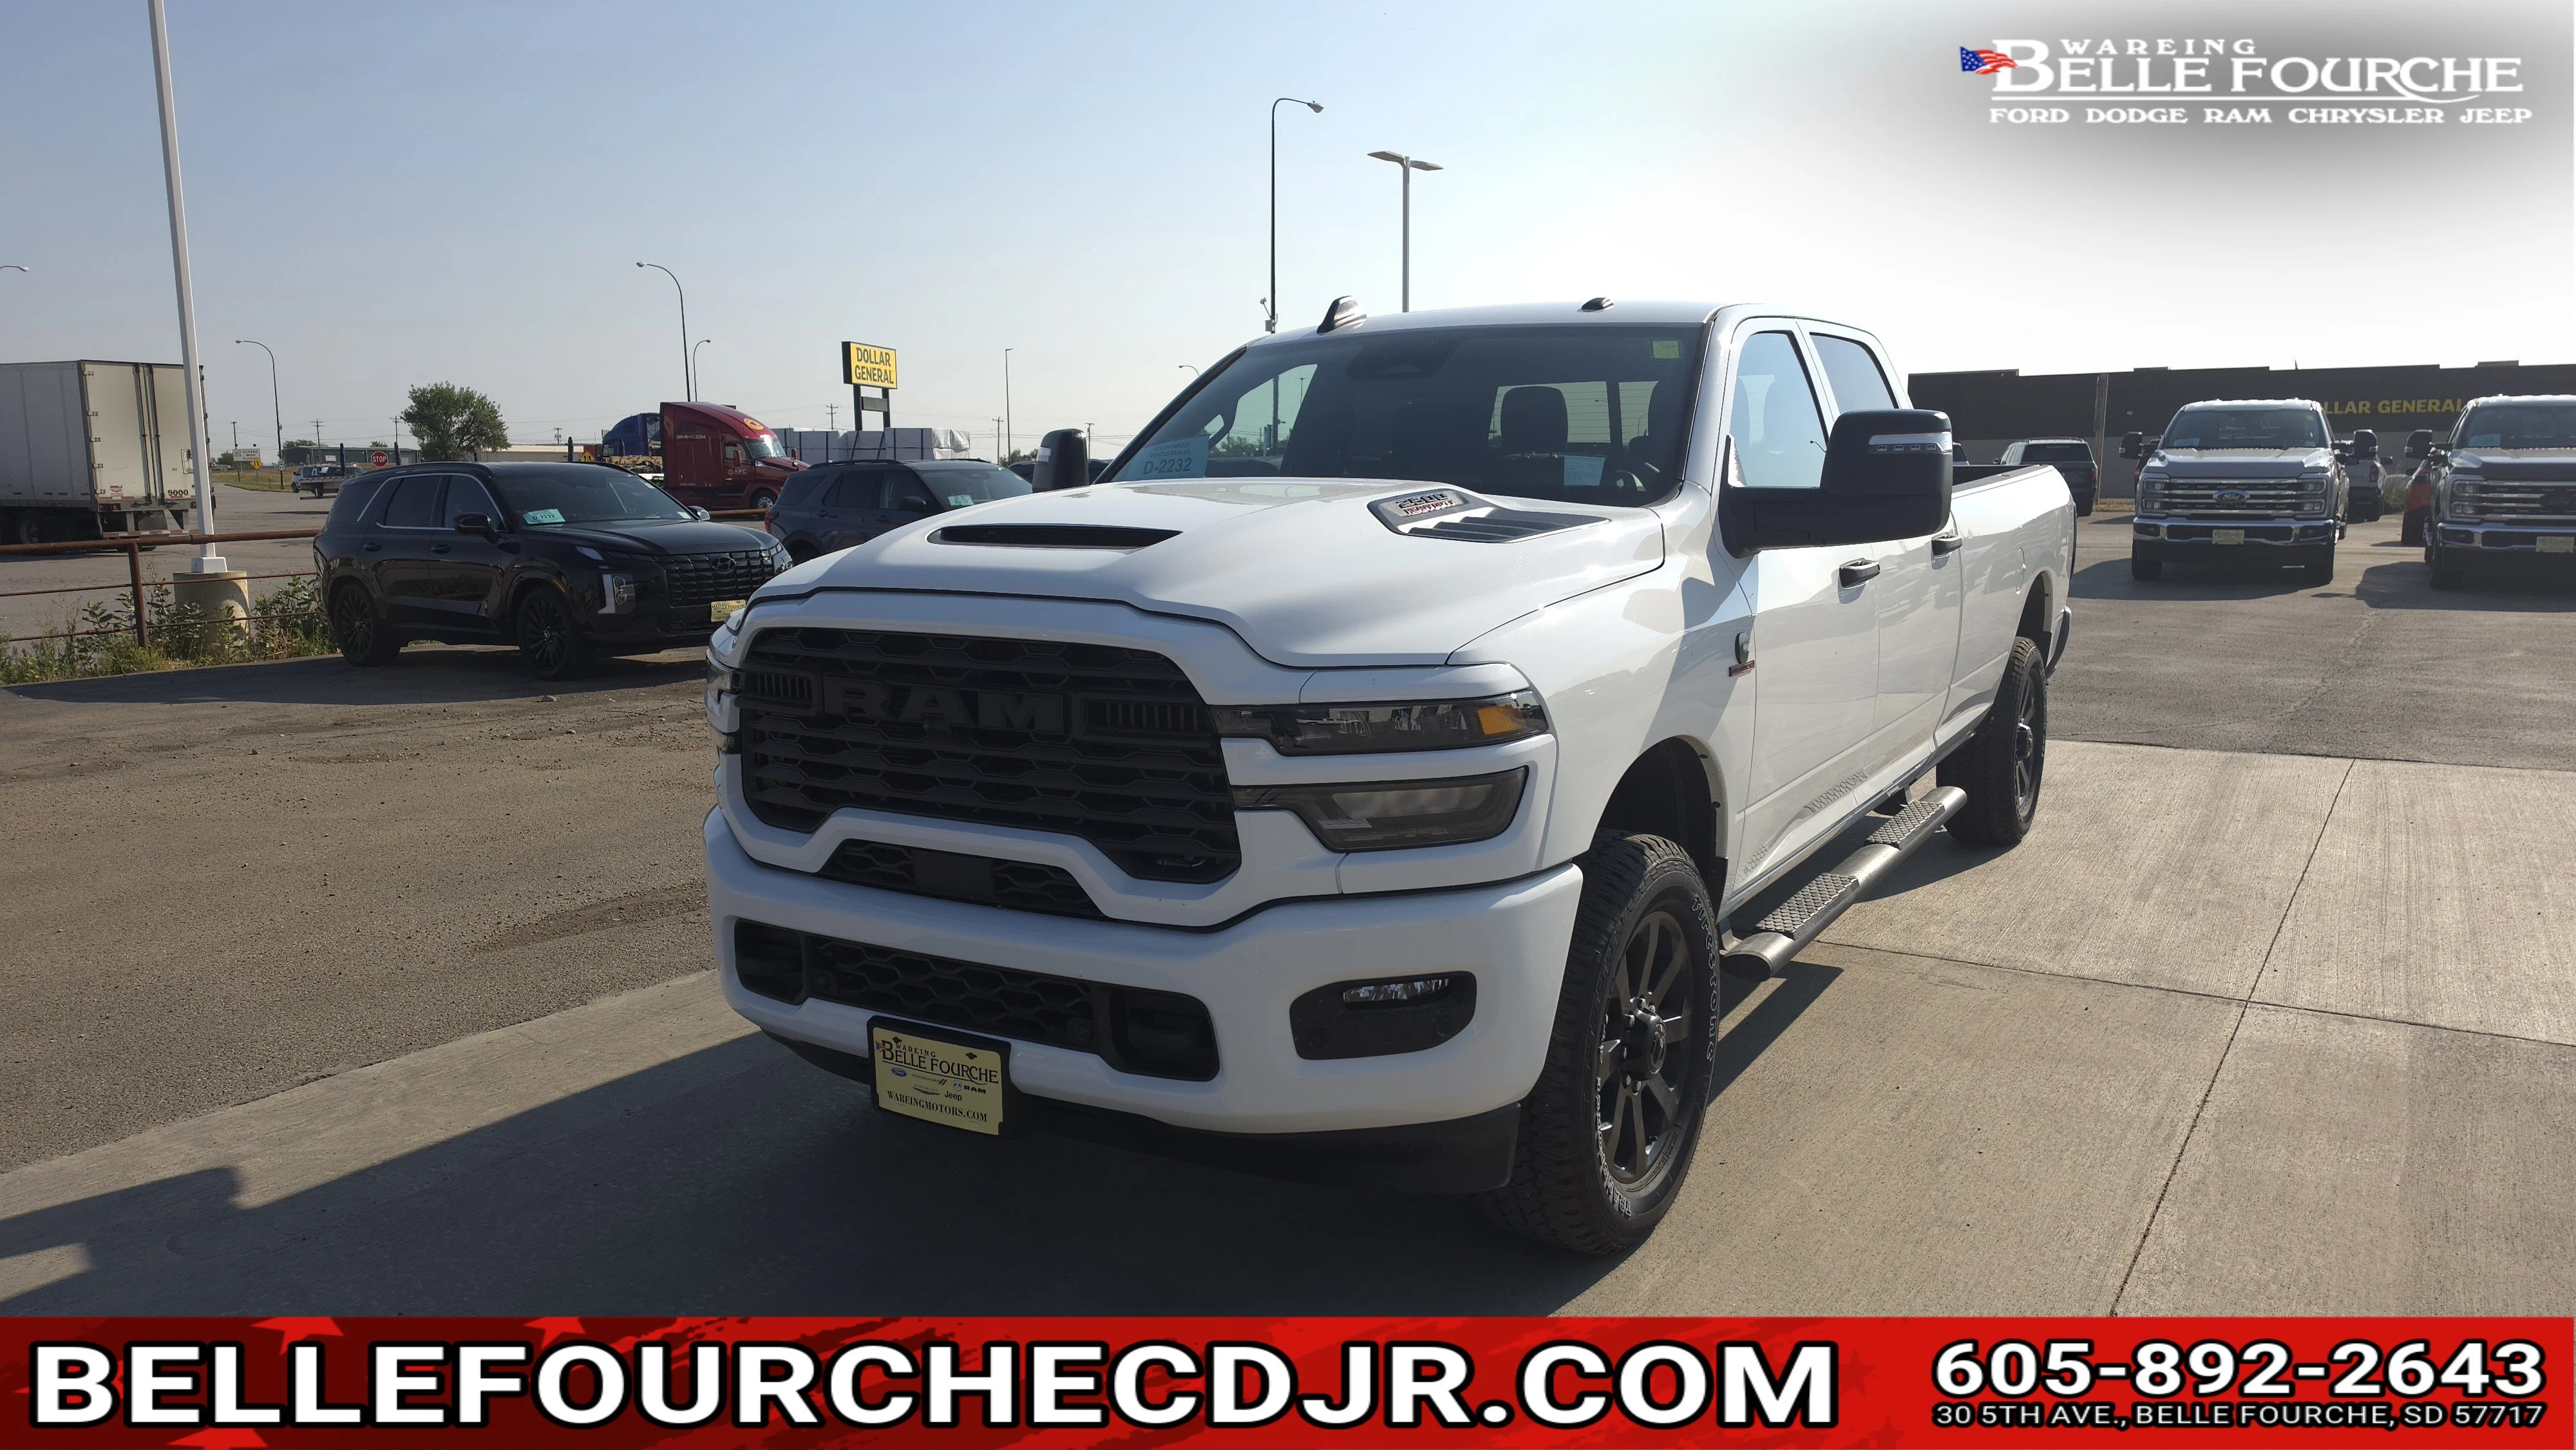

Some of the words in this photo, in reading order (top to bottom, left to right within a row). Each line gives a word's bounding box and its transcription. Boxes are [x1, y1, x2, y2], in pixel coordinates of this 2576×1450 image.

[855, 347, 891, 367] DOLLAR
[855, 364, 894, 384] GENERAL
[2324, 400, 2371, 414] LLAR
[2378, 399, 2462, 413] GENERAL
[1143, 457, 1192, 475] D-2232
[823, 675, 1065, 735] RAM
[1691, 894, 1718, 1062] Firestone
[896, 1042, 936, 1058] WAREING
[881, 1039, 927, 1070] BELLE
[930, 1058, 999, 1086] FOURCHE
[944, 1091, 962, 1102] Jeep
[963, 1084, 987, 1094] RAM
[887, 1089, 988, 1122] WAREINGMOTORS.COM
